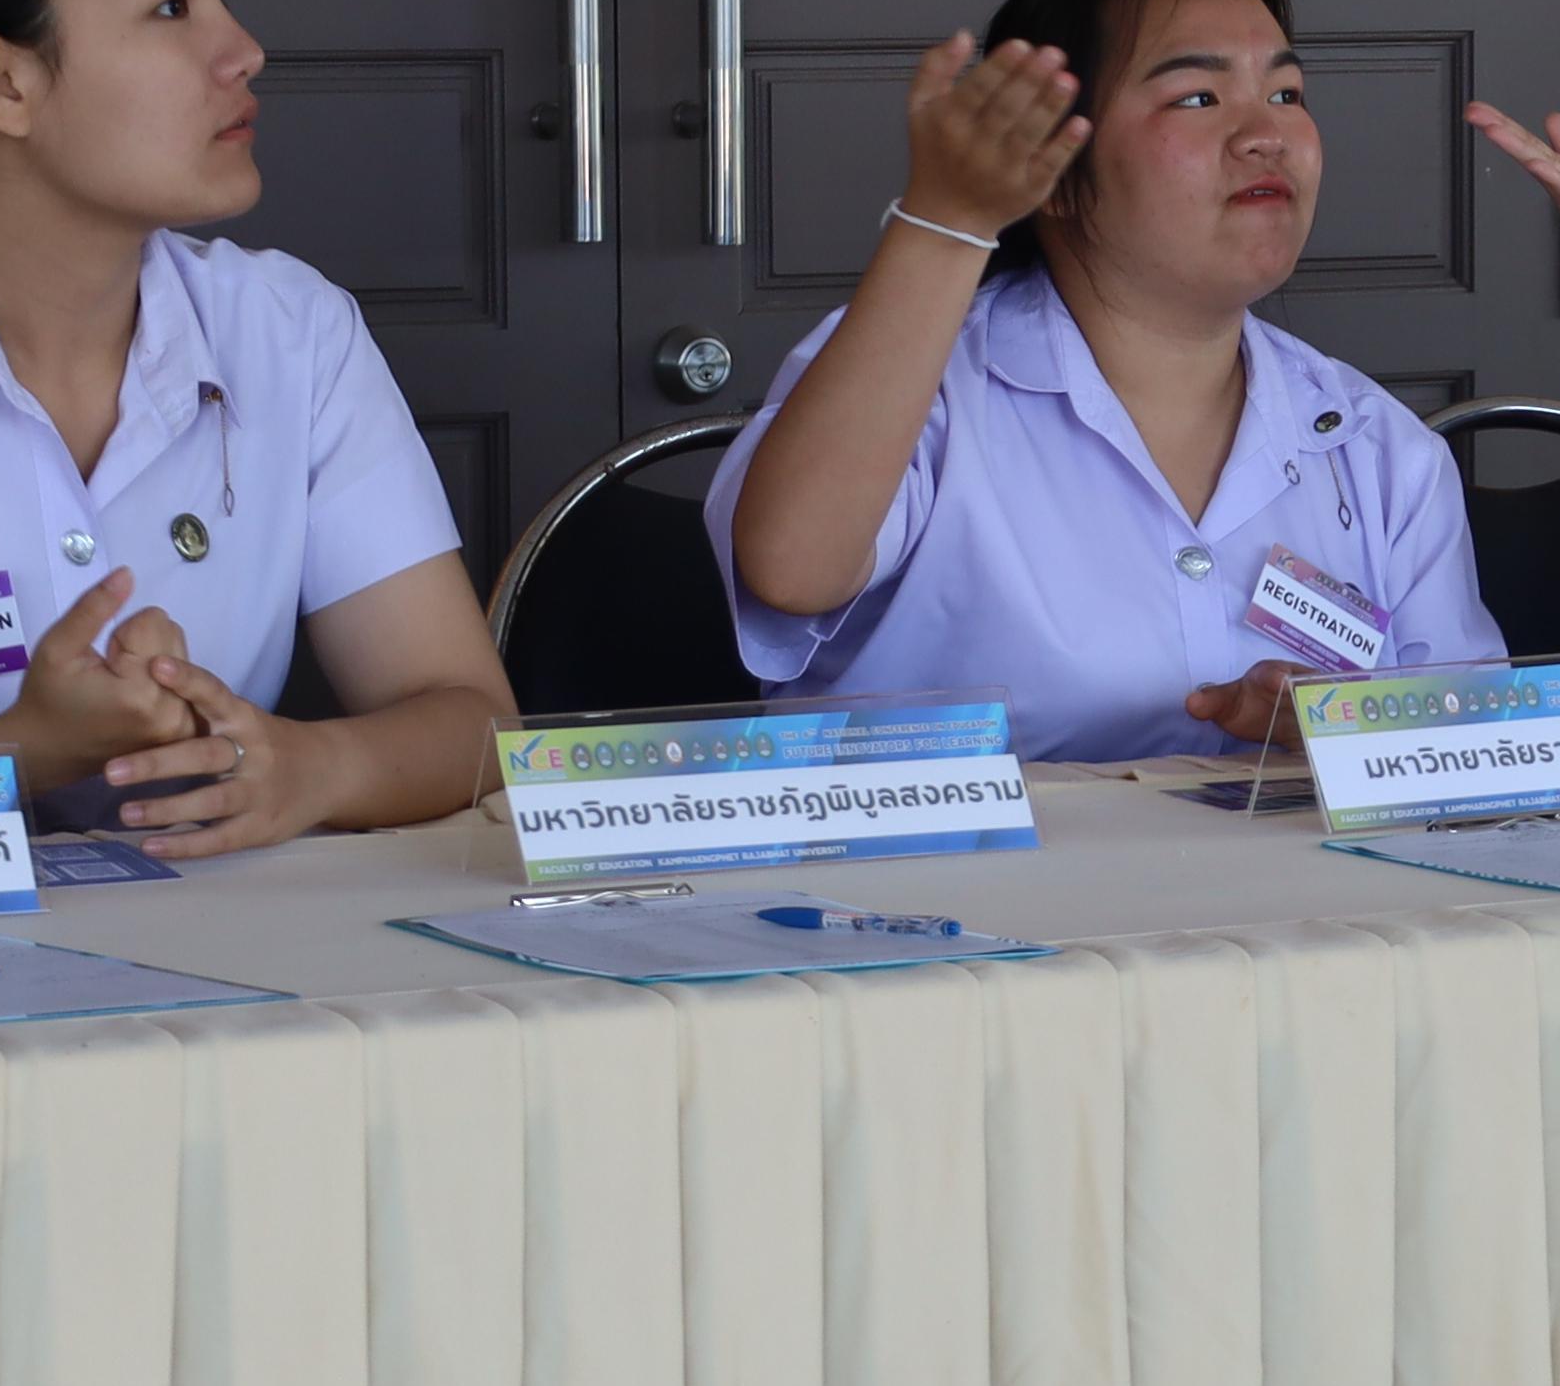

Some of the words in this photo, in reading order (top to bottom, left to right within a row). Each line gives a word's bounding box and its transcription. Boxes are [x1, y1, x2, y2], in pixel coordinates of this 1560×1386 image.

[1263, 579, 1375, 656] REGISTRATION
[509, 749, 565, 772] NCE
[519, 778, 1024, 835] มหาวิทยาลัยราชภัฏพิบูลสงคราม
